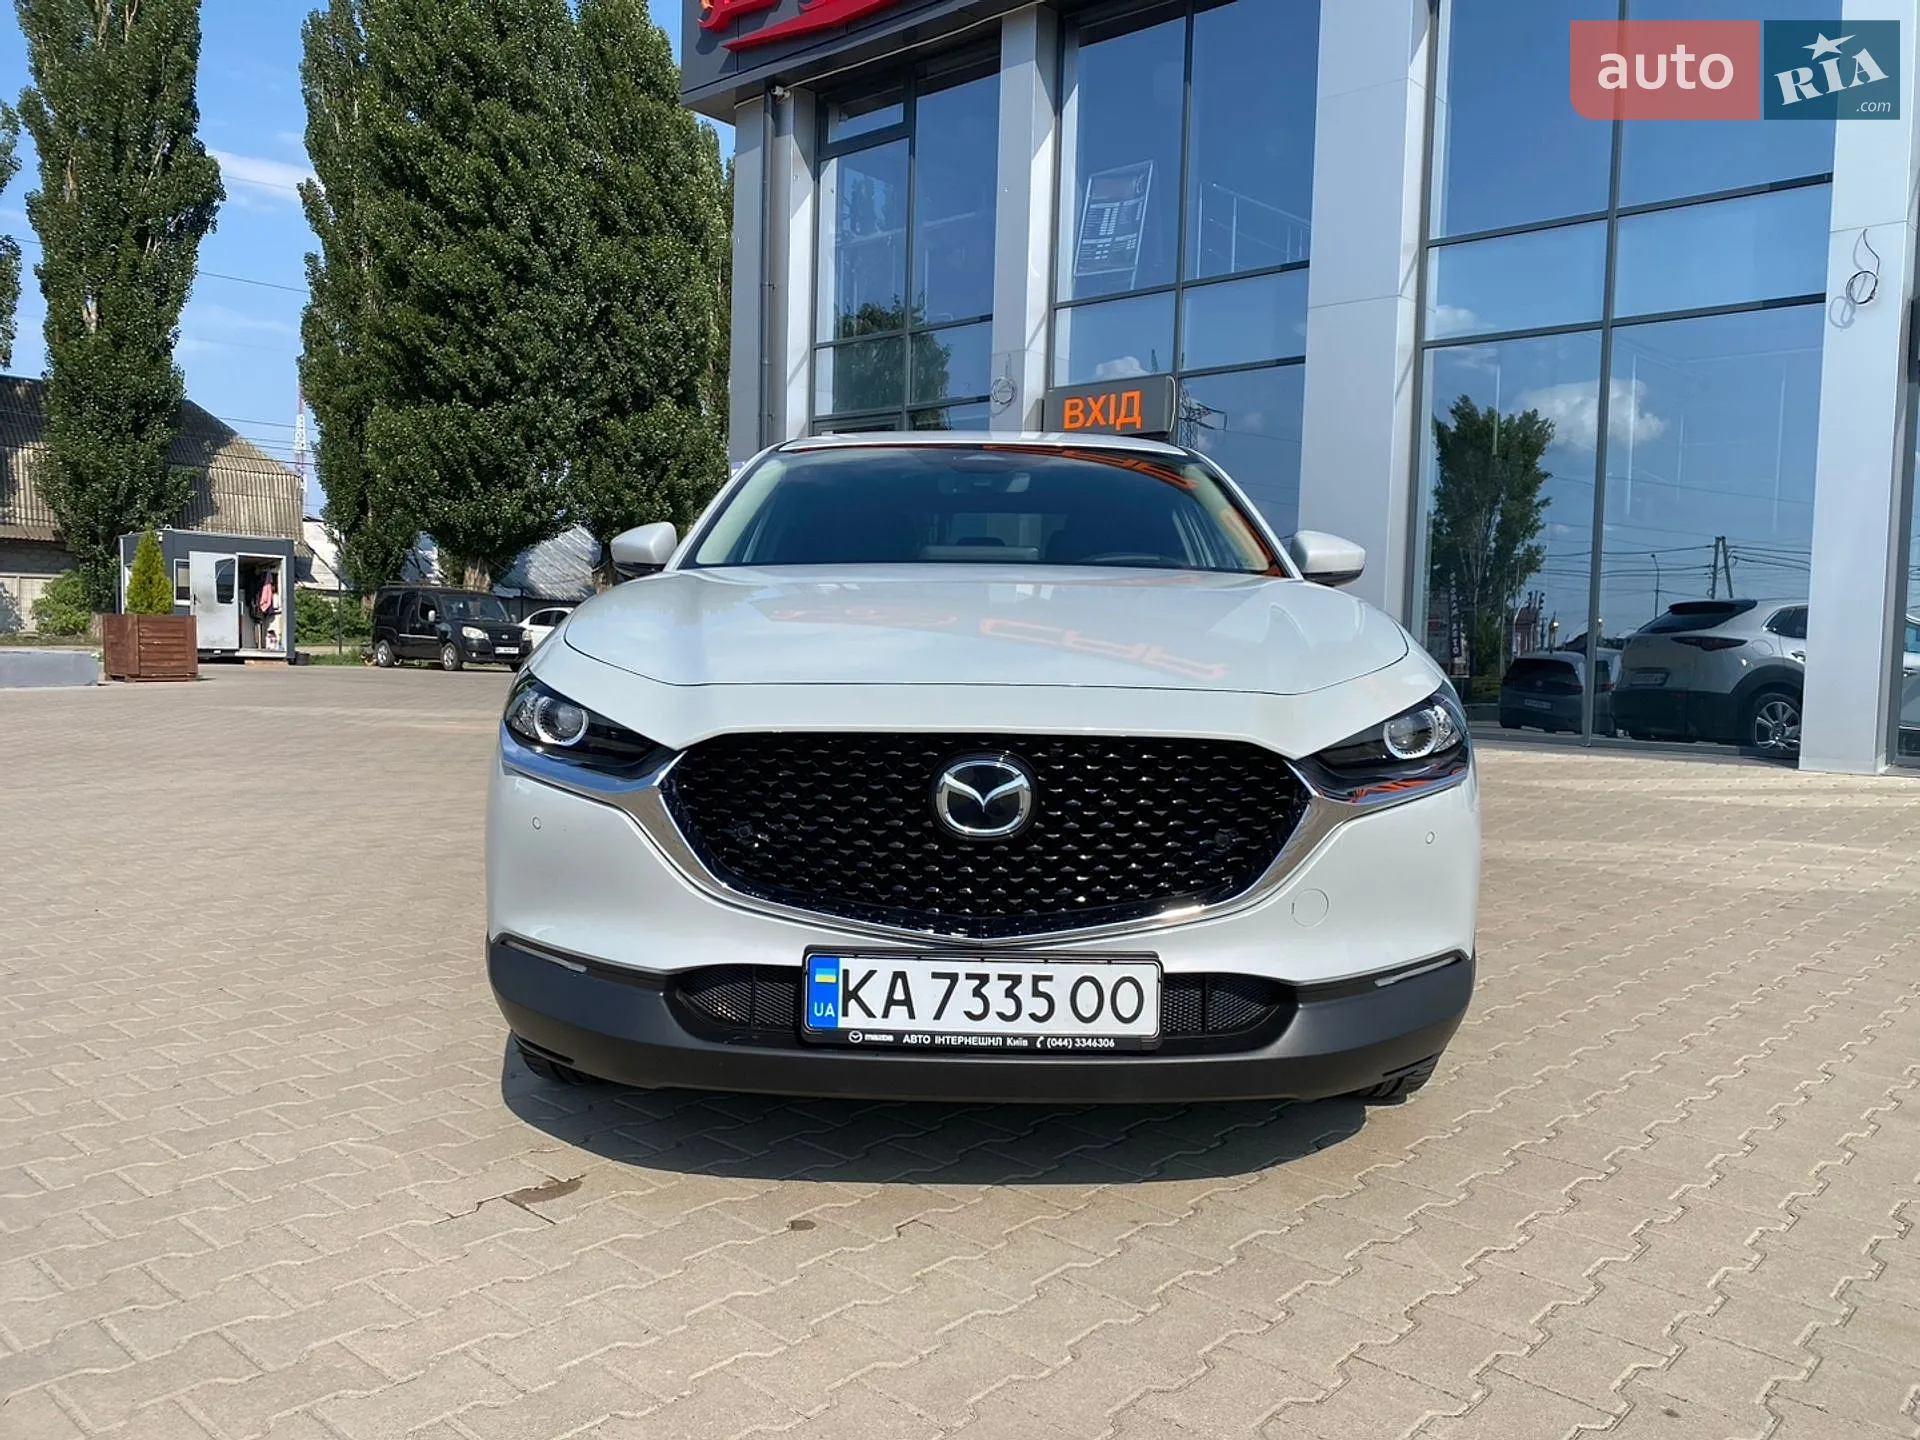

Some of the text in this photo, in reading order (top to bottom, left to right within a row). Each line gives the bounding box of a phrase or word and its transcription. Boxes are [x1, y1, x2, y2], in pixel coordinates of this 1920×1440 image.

[1063, 389, 1143, 431] ВХІД
[813, 1002, 836, 1018] UA
[930, 970, 1056, 1024] 7335
[902, 1033, 931, 1044] АВТО
[1046, 1036, 1072, 1049] (044)
